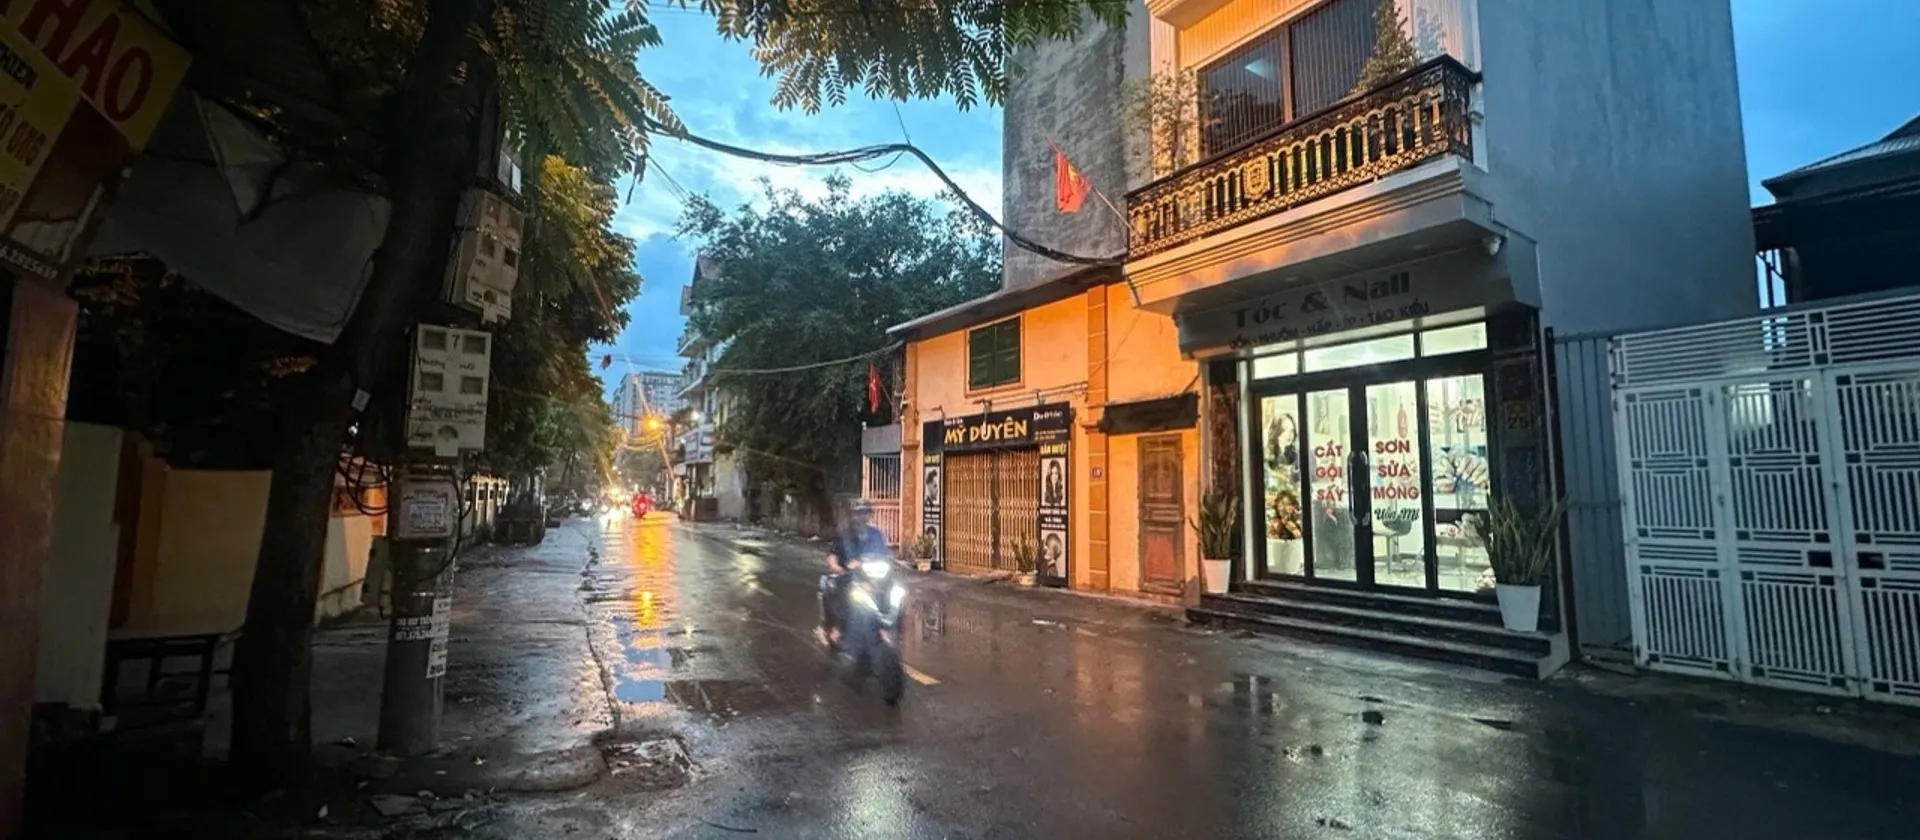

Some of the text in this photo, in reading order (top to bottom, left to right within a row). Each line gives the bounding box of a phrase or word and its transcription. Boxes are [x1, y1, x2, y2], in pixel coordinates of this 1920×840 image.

[1231, 300, 1287, 328] Tóc
[1301, 291, 1329, 313] &
[970, 415, 1027, 442] DUYÊN
[1376, 437, 1410, 454] SƠN
[1316, 463, 1343, 482] GỘI
[1378, 459, 1411, 478] SỬA
[1317, 484, 1345, 502] SẤY
[1373, 482, 1420, 500] MÓNG
